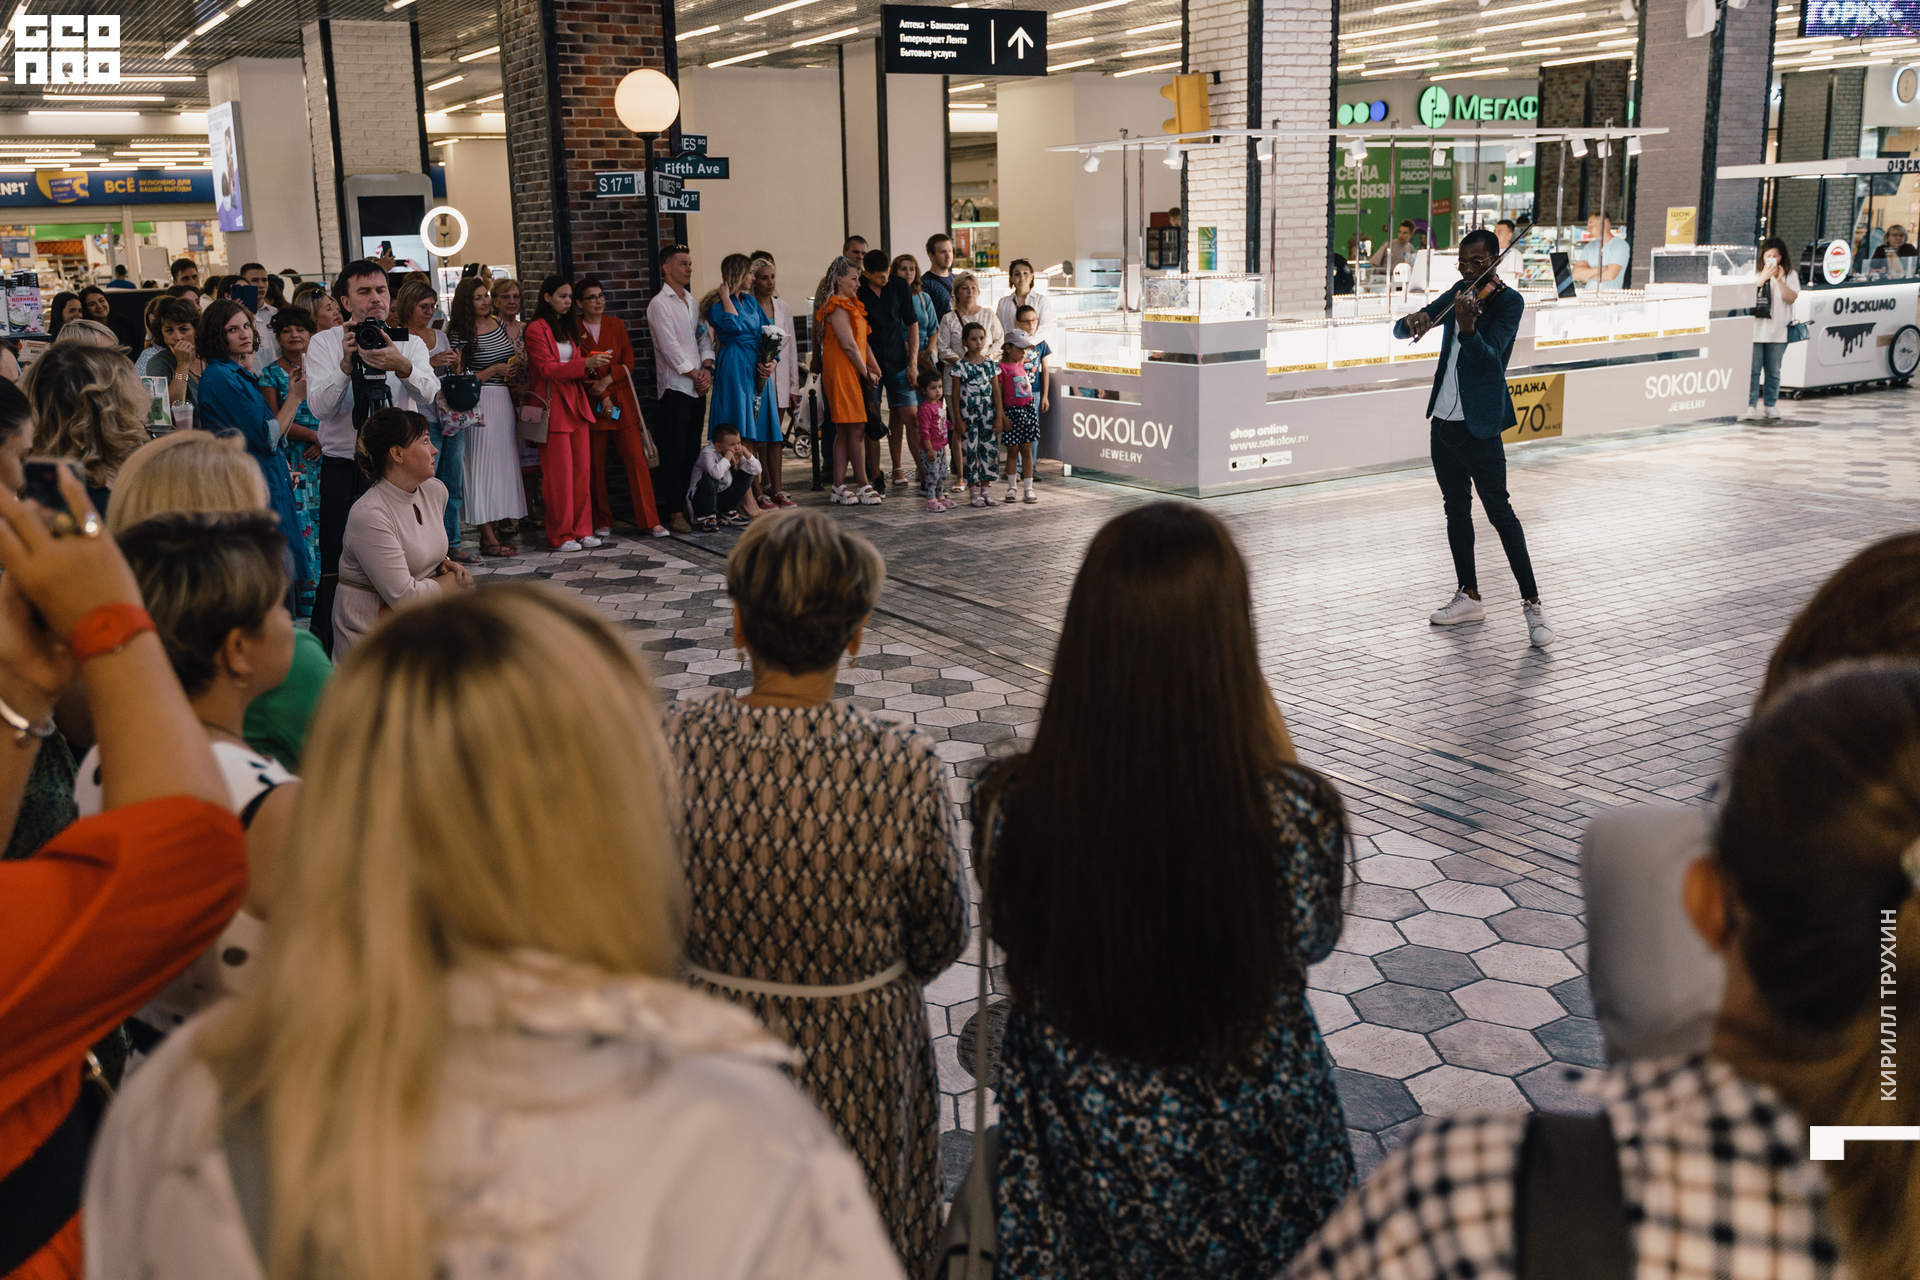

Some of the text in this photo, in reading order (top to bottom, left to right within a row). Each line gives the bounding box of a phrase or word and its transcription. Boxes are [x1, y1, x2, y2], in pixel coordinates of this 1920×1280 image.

[899, 19, 969, 31] Аптека Банкоматы
[900, 33, 968, 46] Гипермаркет Лента
[900, 48, 957, 60] Бытовые услуги
[664, 162, 720, 174] Fifth Ave
[1400, 171, 1452, 182] РАССРЧКА
[104, 177, 136, 194] ВСЁ
[177, 178, 192, 186] ДЛЯ
[600, 178, 608, 192] S
[610, 178, 622, 192] 17
[660, 178, 676, 194] TIMES
[680, 194, 690, 208] 42
[1404, 352, 1438, 360] РАСПРОДАЖА
[1069, 363, 1100, 372] РАСПРОДАЖА
[1278, 364, 1316, 372] РАСПРОДАЖА
[1645, 368, 1733, 400] SOKOLOV
[1668, 399, 1707, 413] JEWELRY
[1072, 412, 1173, 450] SOKOLOV
[1230, 424, 1288, 440] shop online
[1230, 435, 1308, 452] www.sokolov.ru
[1100, 448, 1143, 464] JEWELRY
